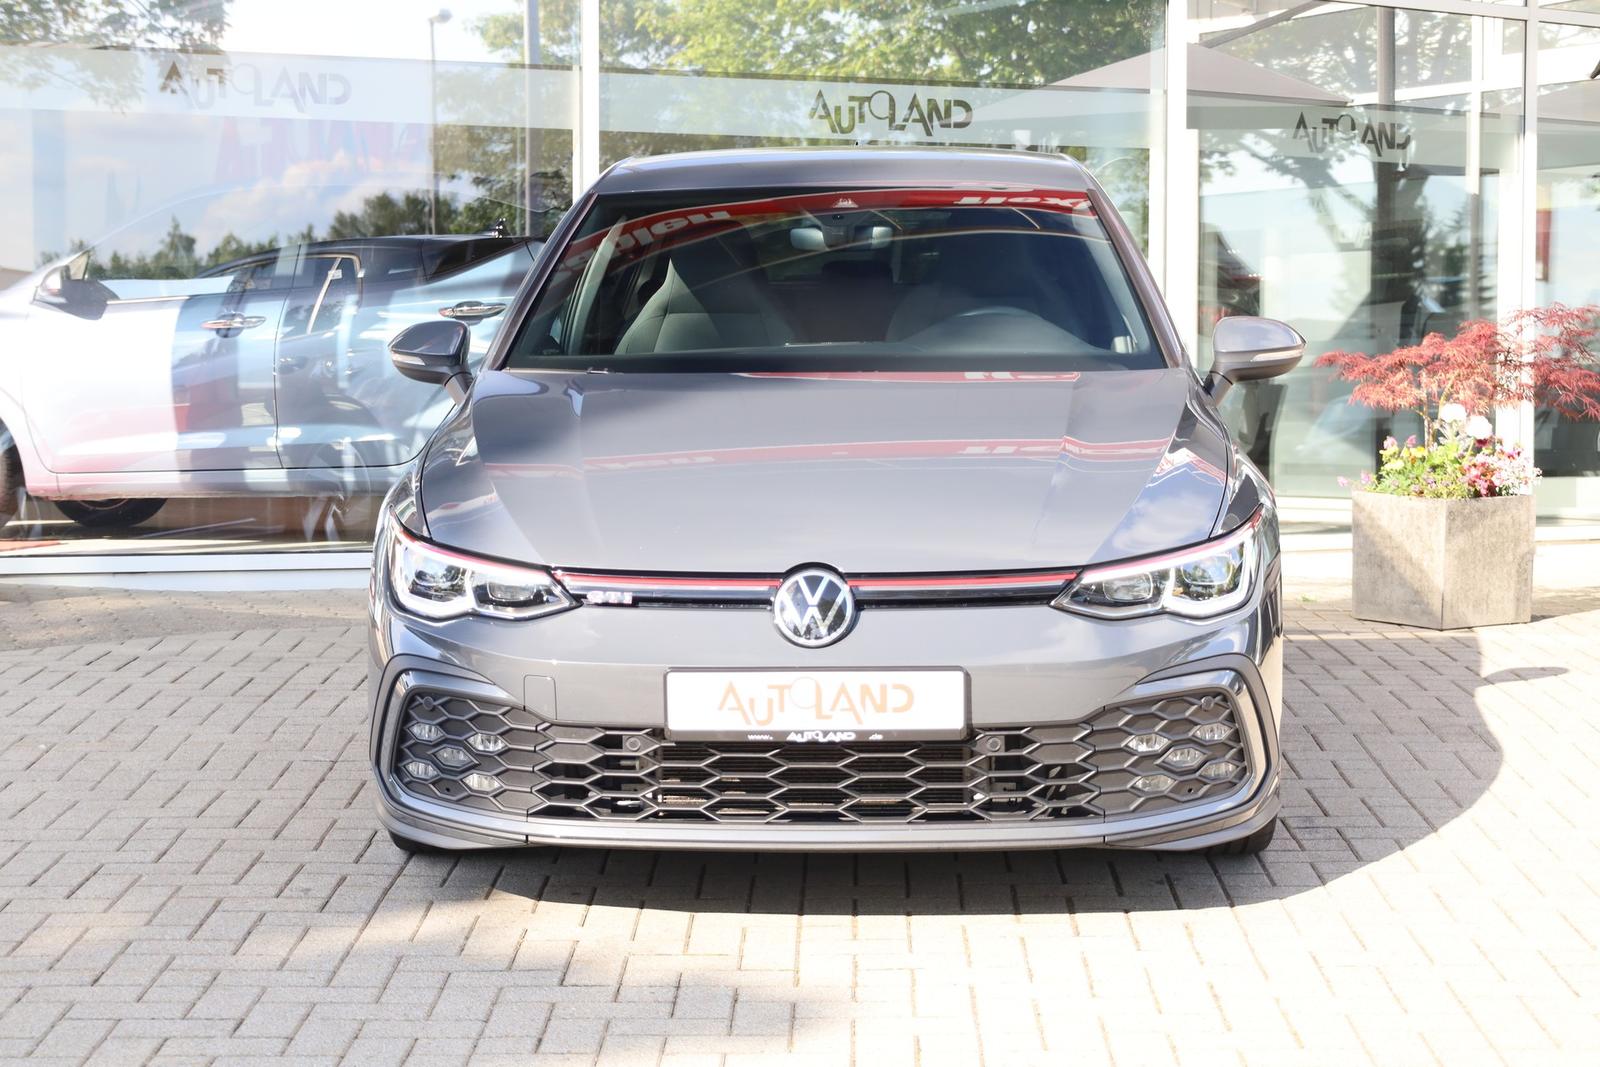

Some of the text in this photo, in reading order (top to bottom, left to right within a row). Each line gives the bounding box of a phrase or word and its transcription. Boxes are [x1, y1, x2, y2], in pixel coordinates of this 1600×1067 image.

[809, 90, 973, 136] AUTOLAND
[717, 677, 915, 726] AUTOLAND
[786, 730, 857, 742] AUTOLAND
